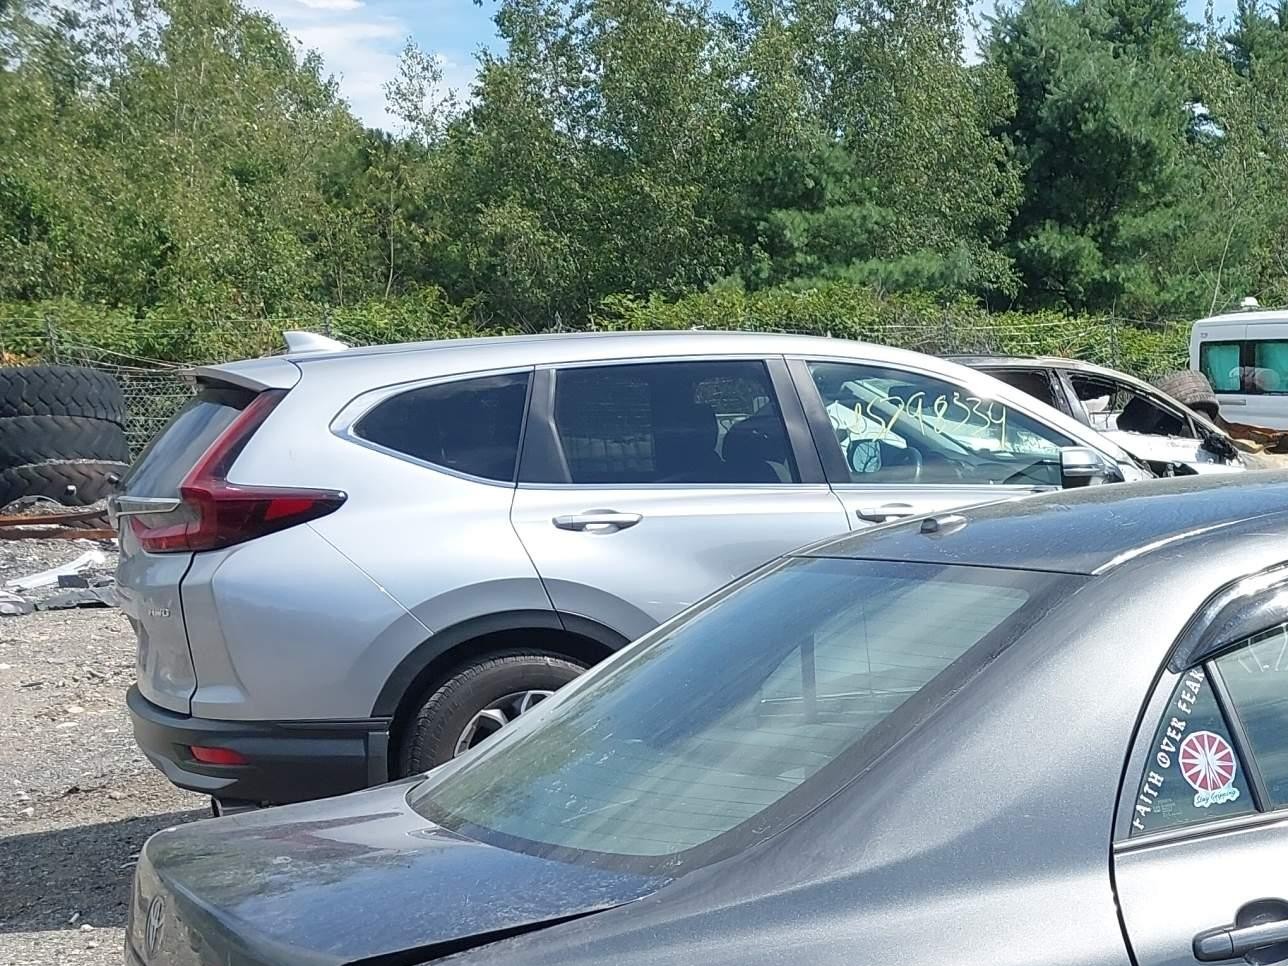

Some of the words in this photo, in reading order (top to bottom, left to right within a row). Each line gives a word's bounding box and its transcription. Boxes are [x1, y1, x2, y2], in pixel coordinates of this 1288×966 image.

[1132, 770, 1165, 830] FAITH
[1156, 717, 1187, 769] OVER
[1177, 669, 1205, 714] FEAR
